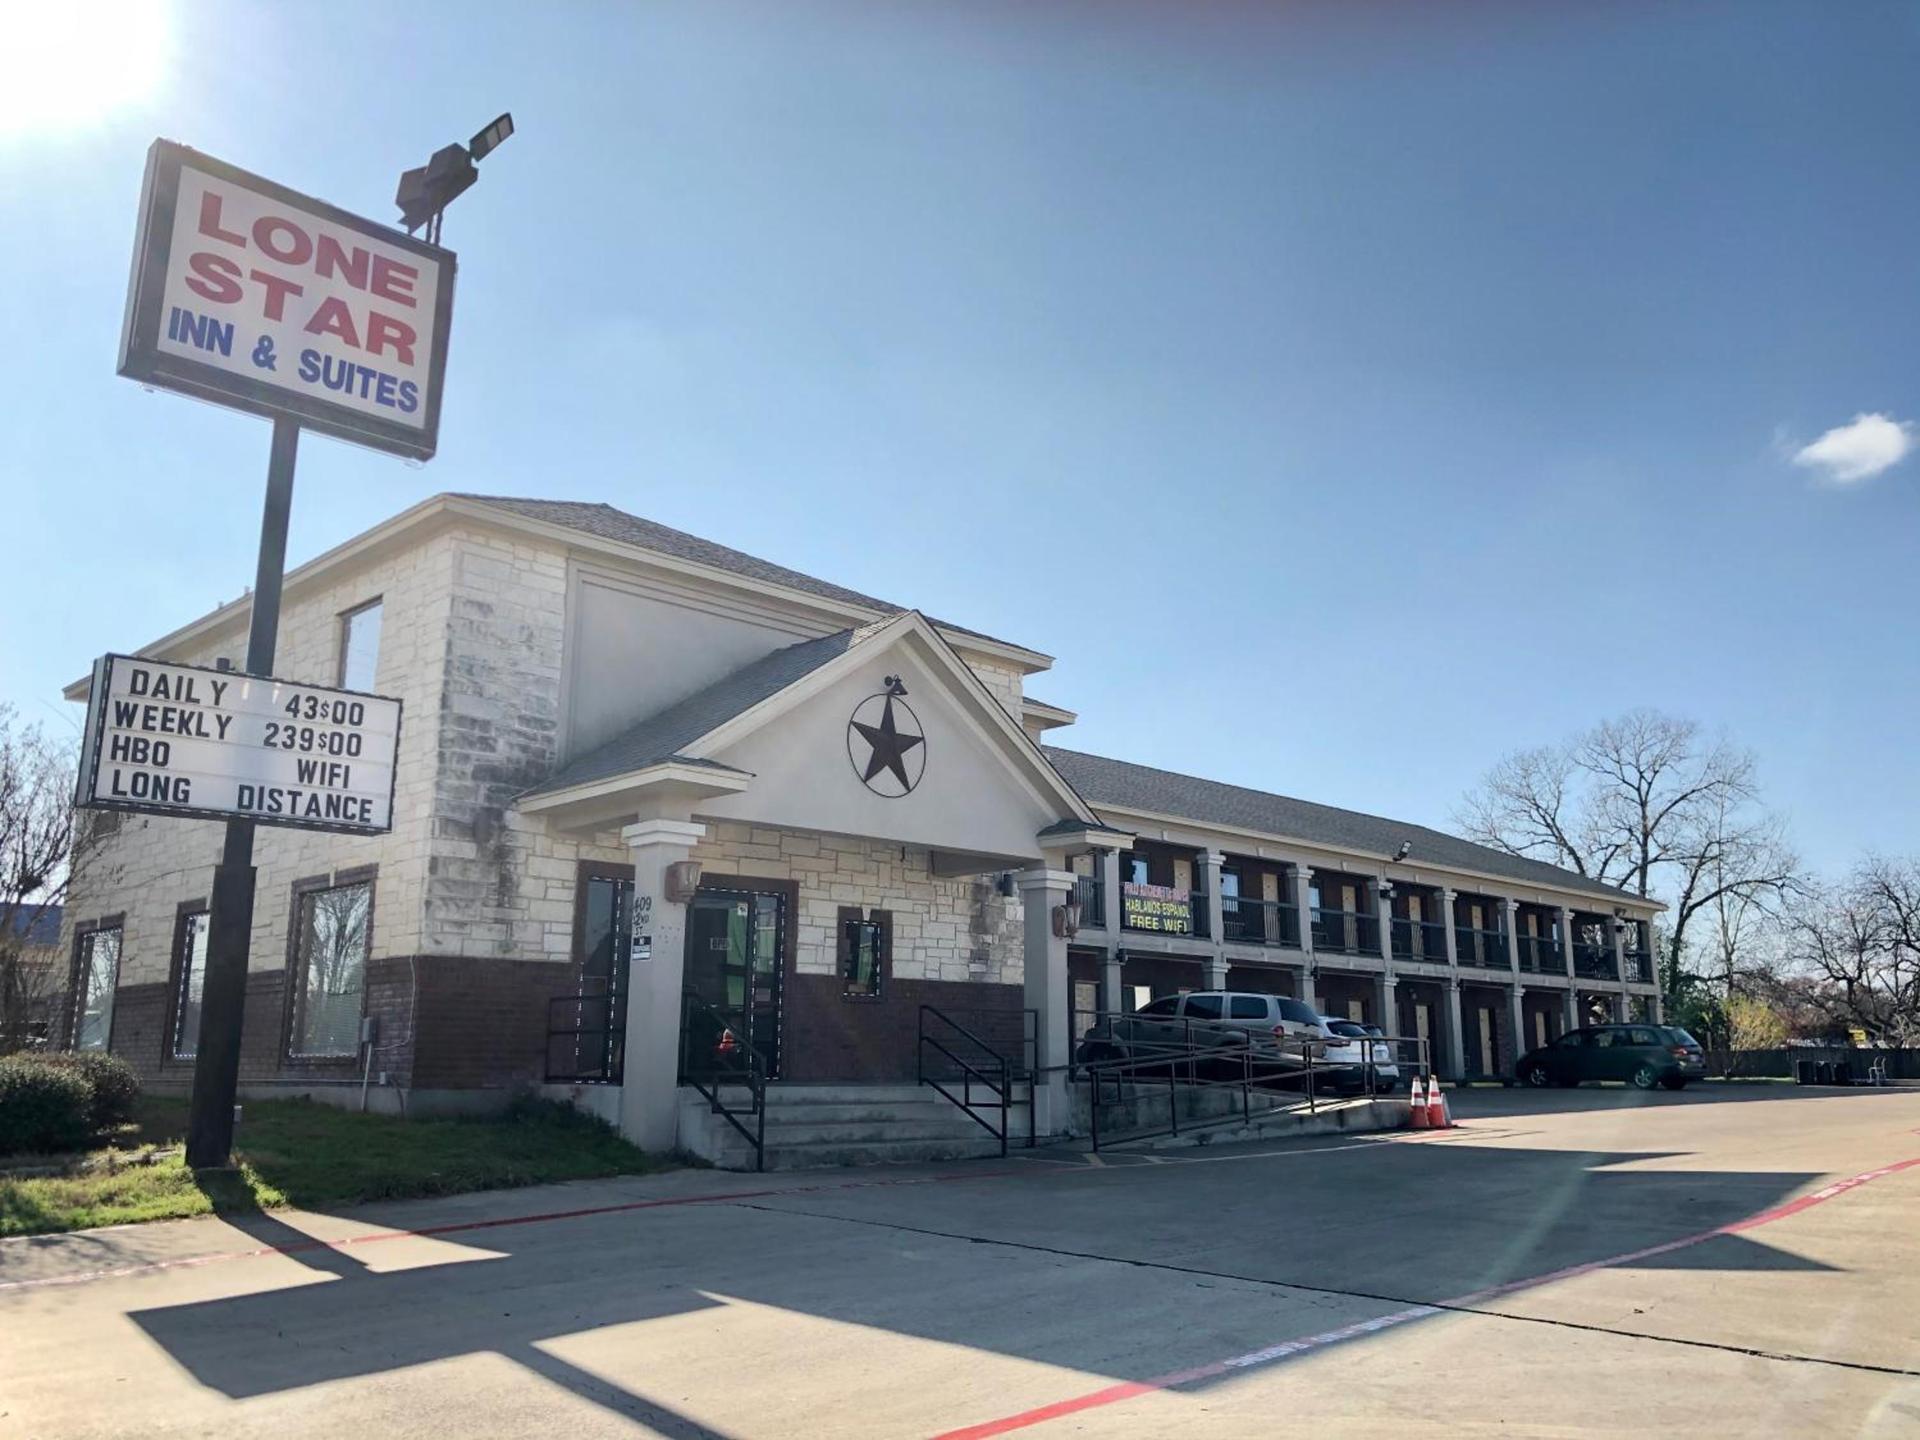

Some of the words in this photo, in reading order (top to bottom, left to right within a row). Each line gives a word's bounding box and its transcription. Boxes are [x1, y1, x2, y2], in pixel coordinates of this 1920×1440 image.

[198, 190, 418, 308] LONE
[185, 251, 417, 367] STAR
[168, 306, 235, 357] INN
[252, 334, 277, 372] &
[298, 348, 419, 413] SUITES
[129, 668, 229, 706] DAILY
[285, 693, 365, 727] 43$00
[114, 700, 233, 740] WEEKLY
[263, 722, 363, 757] 239$00
[110, 734, 171, 767] HBO
[297, 758, 350, 789] WIFI
[111, 769, 191, 804] LONG
[237, 783, 374, 823] DISTANCE
[632, 896, 652, 911] 409
[1129, 914, 1160, 930] FREE
[1163, 917, 1188, 933] WIFI
